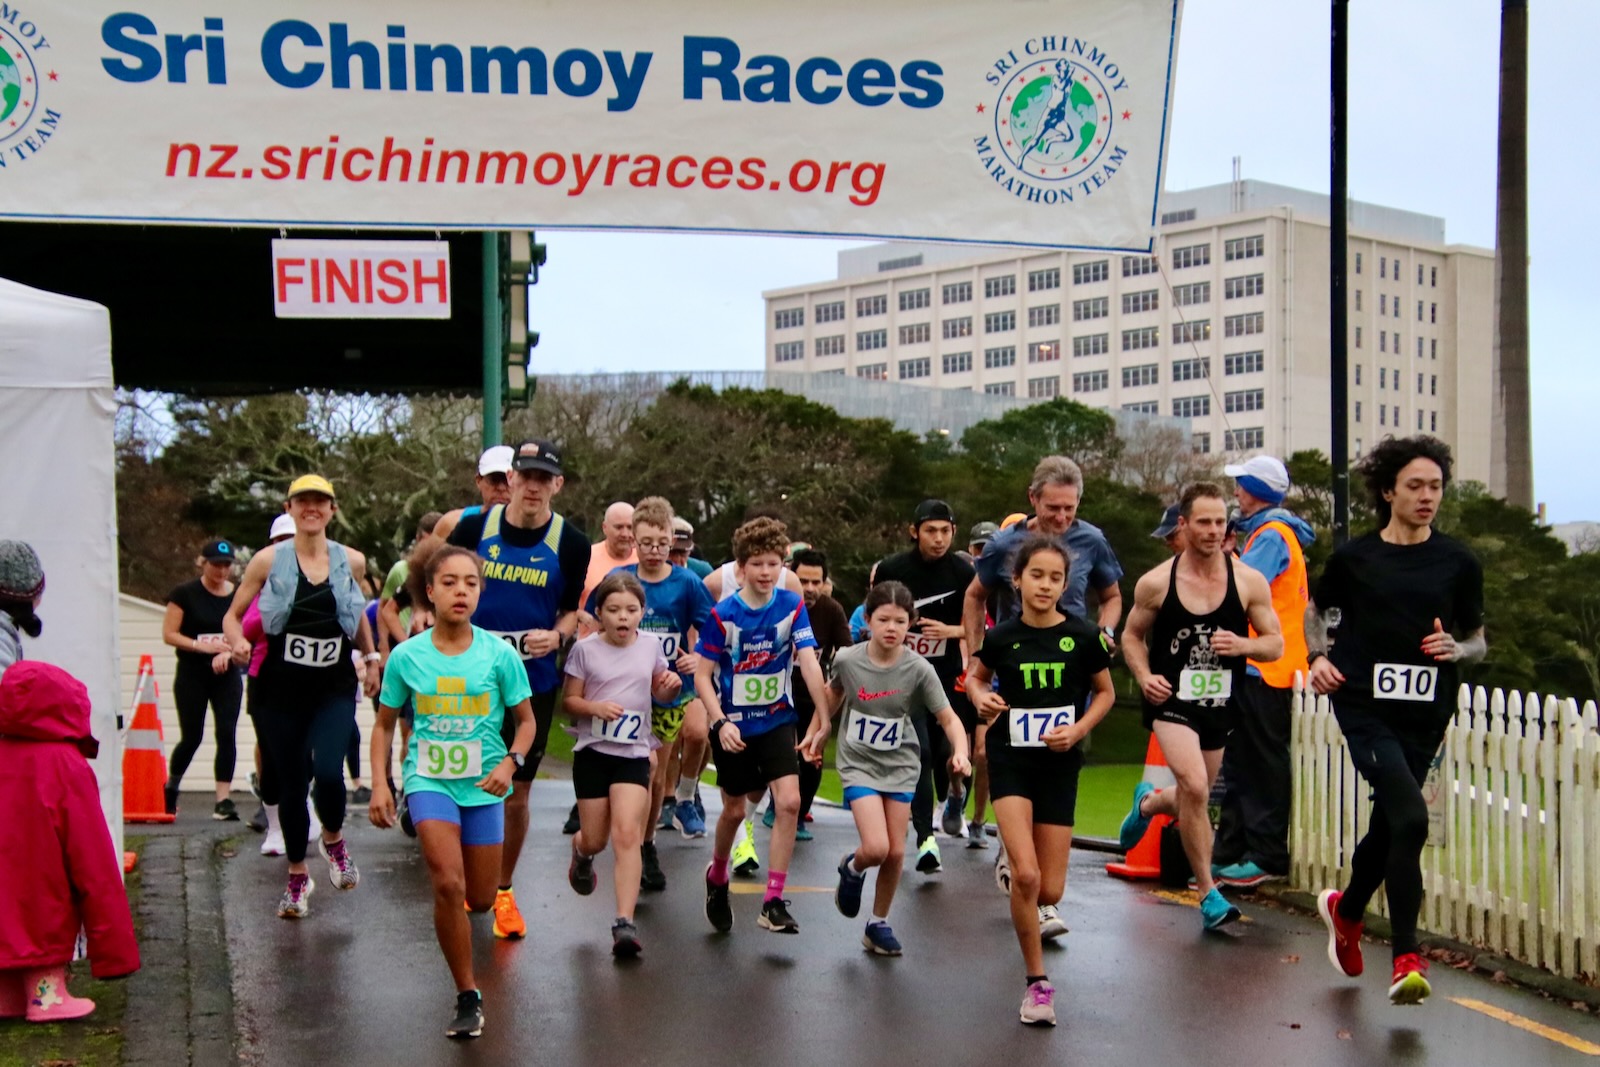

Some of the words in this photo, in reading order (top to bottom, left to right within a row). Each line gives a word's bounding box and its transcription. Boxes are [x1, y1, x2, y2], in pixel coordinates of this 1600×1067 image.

[101, 12, 228, 85] Sri
[261, 20, 653, 112] Chinmoy
[683, 35, 945, 109] Races
[986, 50, 1019, 86] SRI
[1025, 36, 1129, 92] CHINMOY
[10, 108, 62, 161] TEAM
[165, 135, 887, 206] nz.srichinmoyraces.org
[973, 134, 1074, 205] MARATHON
[1078, 145, 1129, 196] TEAM
[276, 257, 447, 305] FINISH
[290, 638, 337, 663] 612
[744, 676, 779, 702] 98
[1019, 662, 1066, 690] TTT
[1190, 672, 1223, 697] 95
[1378, 667, 1432, 696] 610
[427, 716, 476, 733] 2023
[602, 714, 641, 740] 172
[855, 717, 898, 746] 174
[428, 743, 469, 775] 99
